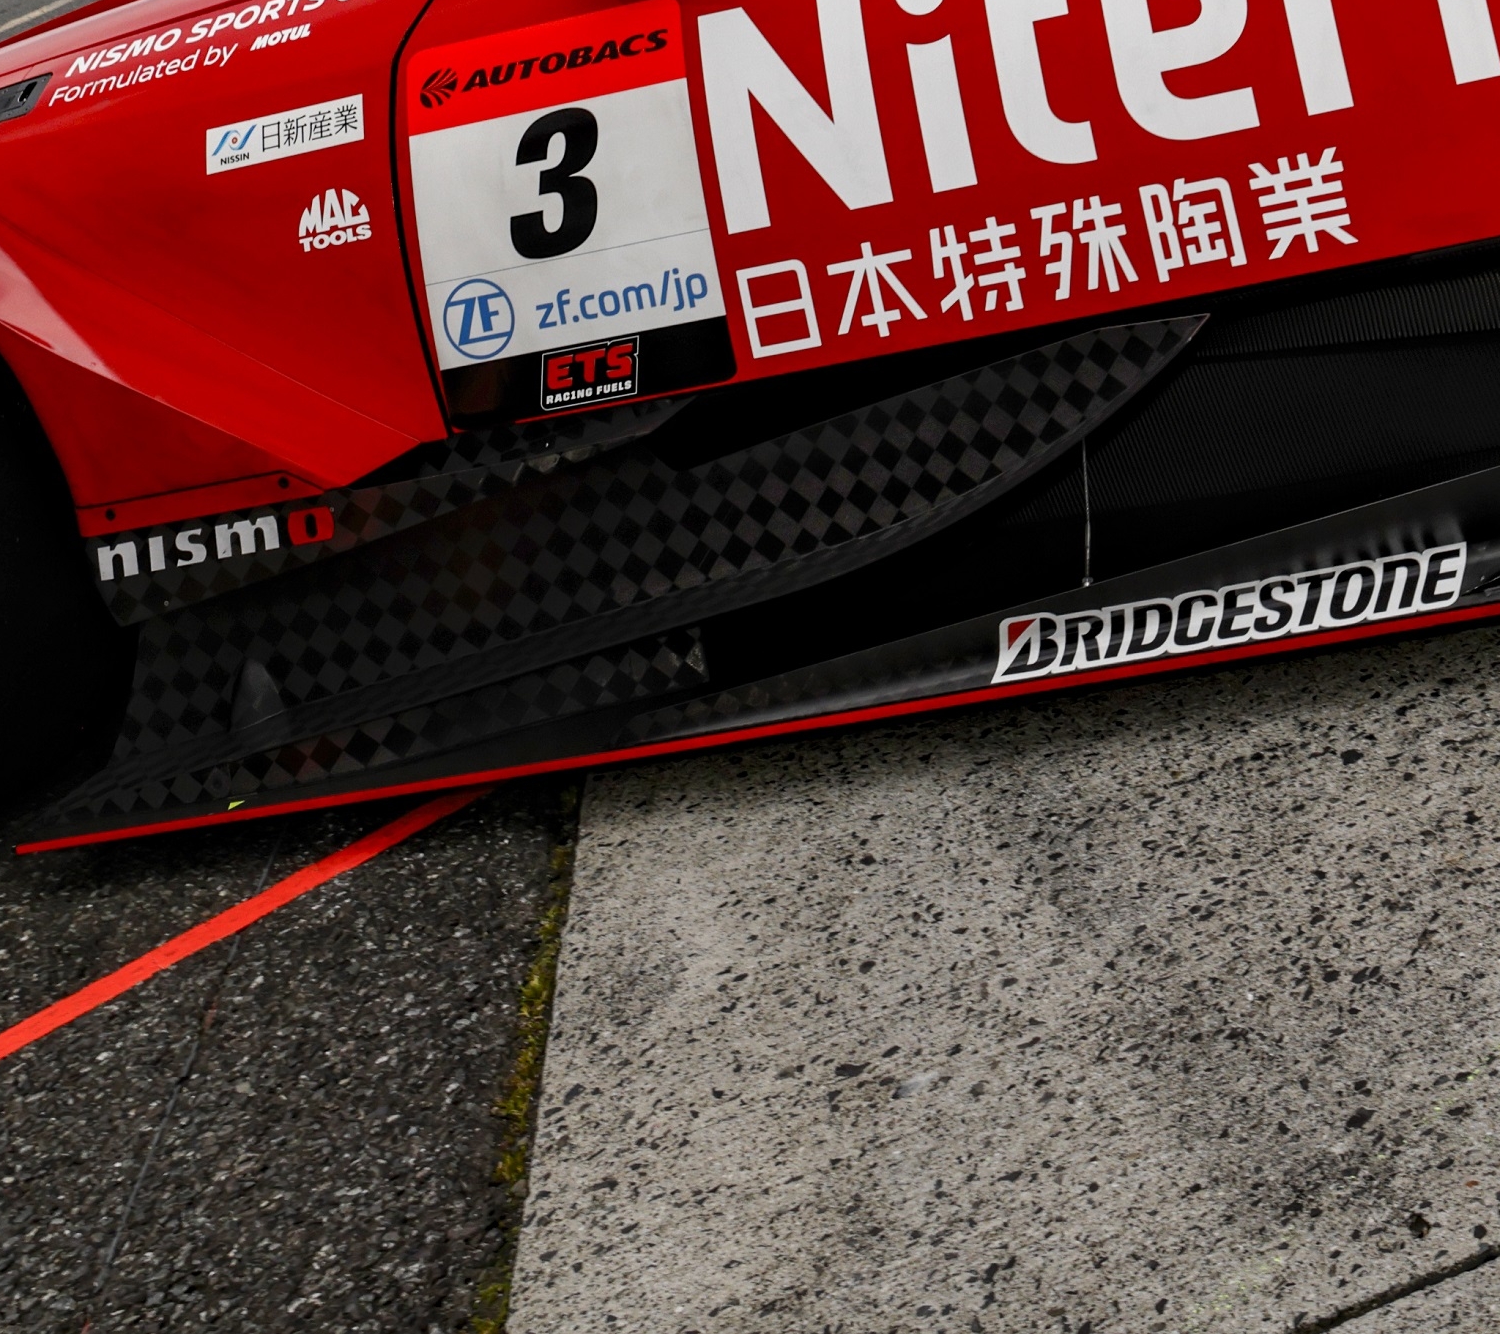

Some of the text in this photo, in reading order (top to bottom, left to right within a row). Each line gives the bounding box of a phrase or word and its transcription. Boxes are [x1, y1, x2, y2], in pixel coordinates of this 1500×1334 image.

[49, 23, 310, 107] Formulated by MOTUL
[65, 26, 181, 77] NISMO
[460, 29, 668, 94] AUTOBACS
[262, 104, 358, 153] 日新産業
[220, 152, 250, 166] NISSIN
[510, 108, 598, 260] 3
[299, 187, 369, 239] MAC
[299, 223, 372, 253] TOOLS
[737, 147, 1358, 360] 日本特殊陶業
[536, 266, 709, 330] zf.com/jp
[546, 342, 634, 390] ETS
[596, 379, 632, 396] FUELS
[99, 507, 335, 581] nismo
[994, 543, 1467, 683] BRIDGESTONE
